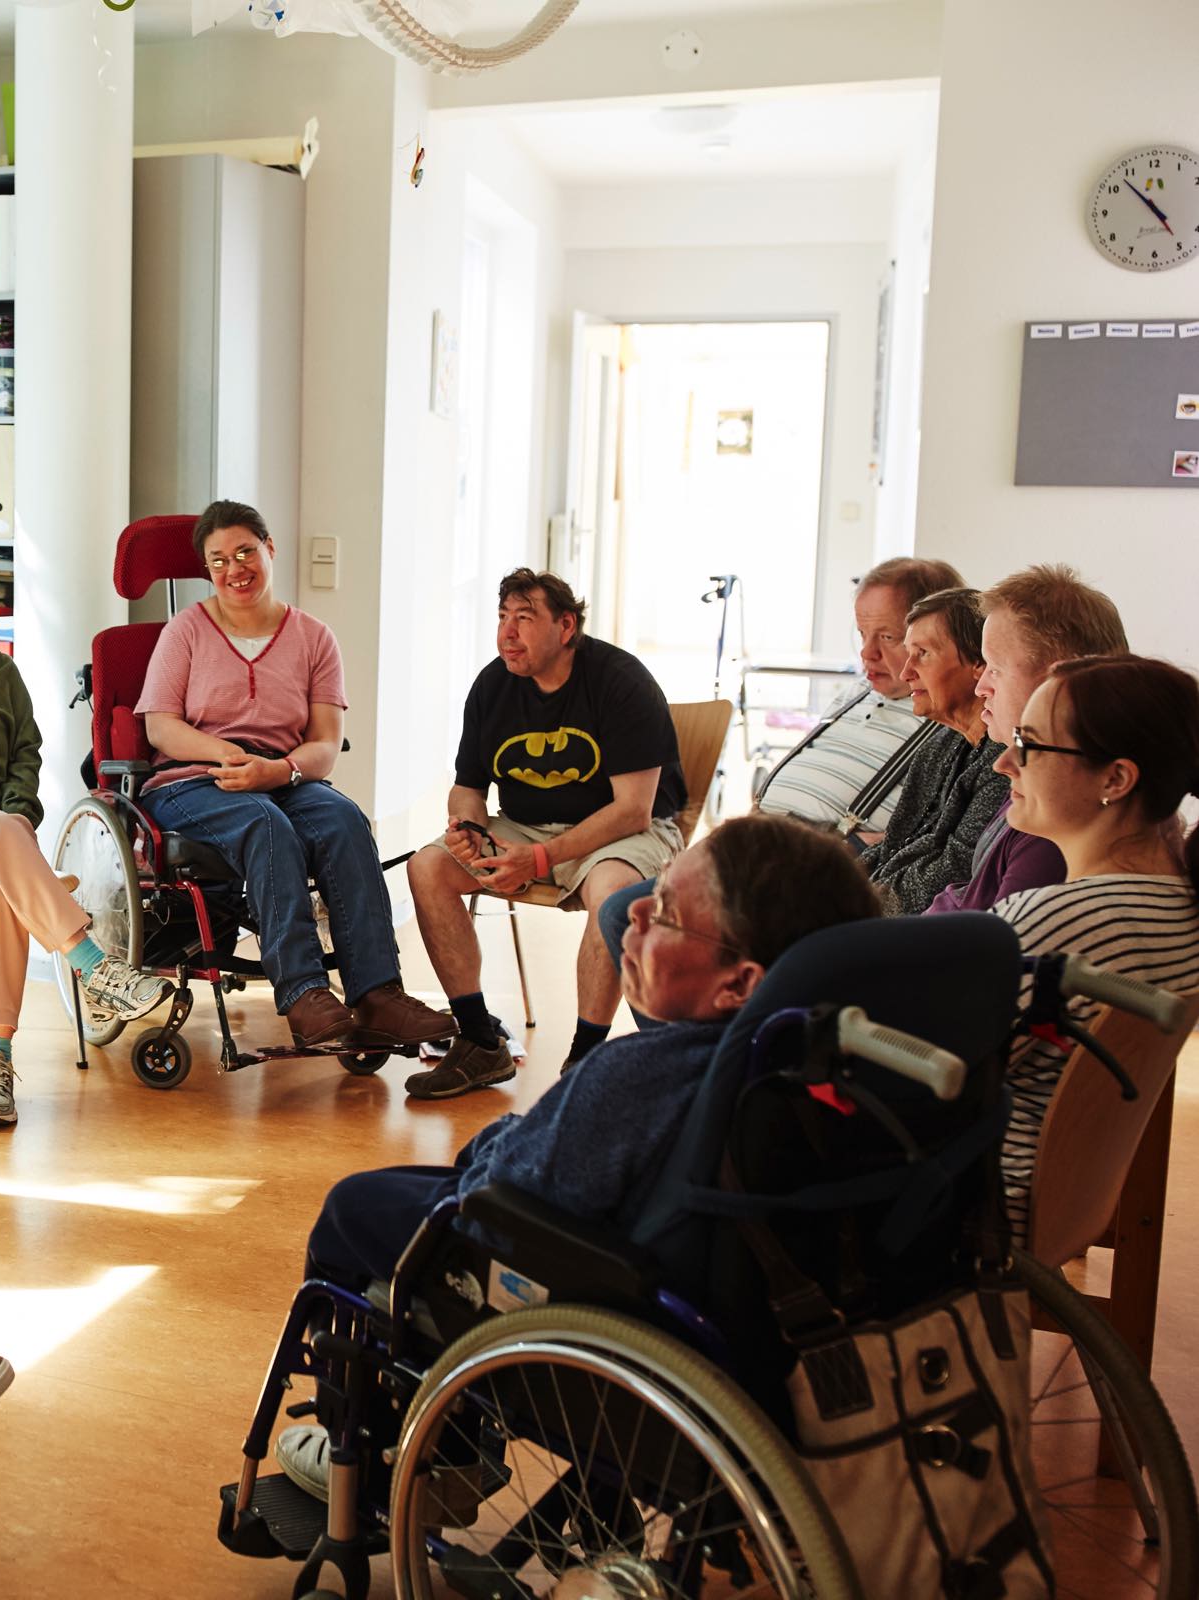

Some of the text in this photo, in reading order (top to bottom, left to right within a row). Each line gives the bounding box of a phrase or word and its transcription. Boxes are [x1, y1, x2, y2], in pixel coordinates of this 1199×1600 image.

[1149, 159, 1161, 169] 12
[1125, 167, 1135, 177] 11
[1108, 185, 1120, 194] 10
[1102, 209, 1108, 218] 9
[1109, 232, 1116, 241] 8
[1128, 246, 1134, 255] 7
[1176, 242, 1183, 251] 5
[1151, 250, 1158, 259] 6
